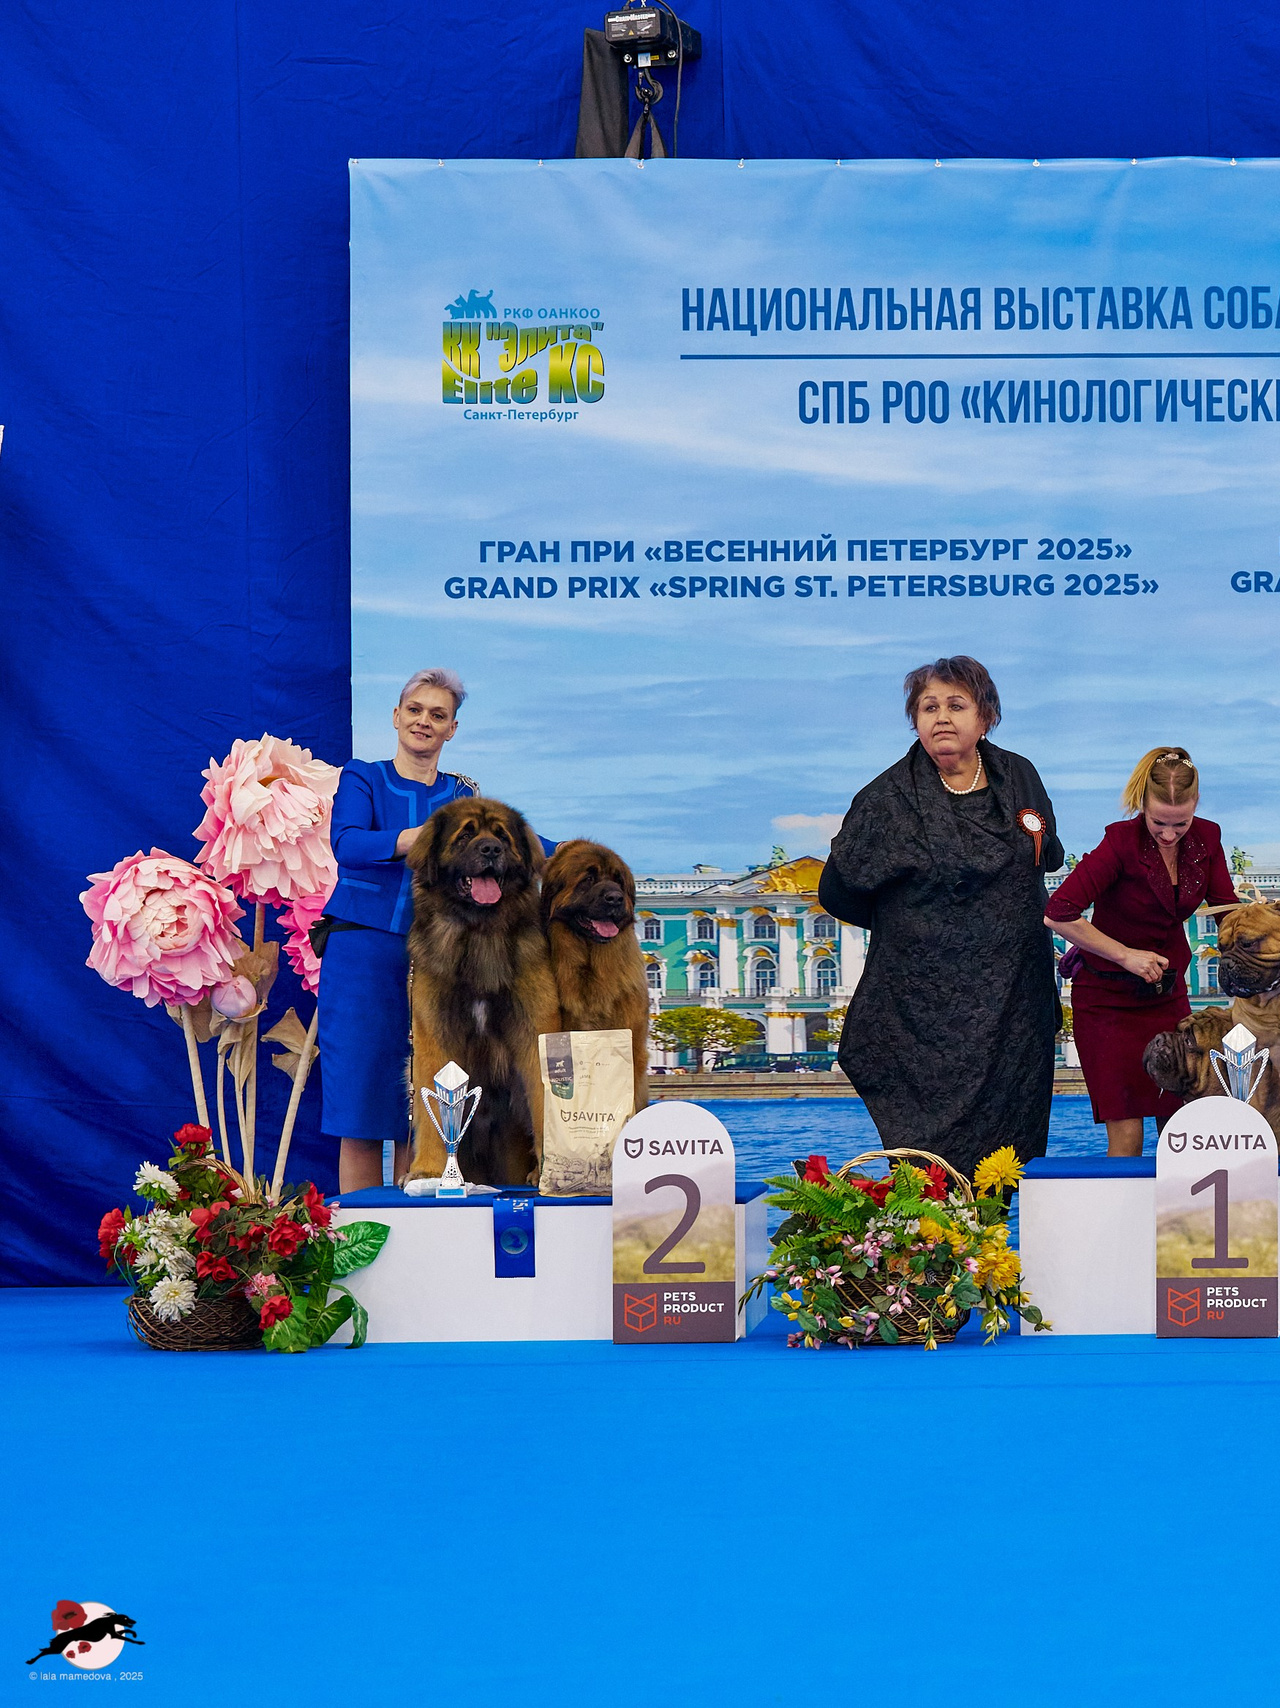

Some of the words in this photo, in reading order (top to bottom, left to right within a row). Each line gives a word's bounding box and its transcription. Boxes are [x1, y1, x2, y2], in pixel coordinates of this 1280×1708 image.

[503, 307, 533, 319] РКФ
[537, 307, 601, 319] ОАНКОО
[683, 288, 980, 336] НАЦИОНАЛЬНАЯ
[995, 287, 1193, 330] ВЫСТАВКА
[441, 359, 538, 405] Elite
[799, 381, 869, 424] СПБ
[883, 381, 949, 424] РОО
[463, 408, 579, 422] Санкт-Петербург
[480, 541, 560, 563] ГРАН
[571, 541, 634, 562] ПРИ
[645, 534, 836, 562] «ВЕСЕННИЙ
[848, 539, 1028, 561] ПЕТЕРБУРГ
[1038, 538, 1132, 560] 2025»
[445, 577, 557, 599] GRAND
[569, 576, 640, 598] PRIX
[650, 576, 784, 598] «SPRING
[795, 576, 837, 597] ST.
[848, 574, 1054, 597] PETERSBURG
[1064, 574, 1159, 596] 2025»
[572, 1111, 616, 1122] SAVITA
[648, 1139, 724, 1156] SAVITA
[1192, 1134, 1267, 1150] SAVITA
[642, 1173, 706, 1275] 2
[1190, 1168, 1249, 1269] 1
[663, 1291, 696, 1301] PETS
[1207, 1286, 1239, 1296] PETS
[663, 1302, 725, 1313] PRODUCT
[1207, 1298, 1268, 1308] PRODUCT
[664, 1316, 682, 1325] RU
[1207, 1310, 1225, 1320] RU
